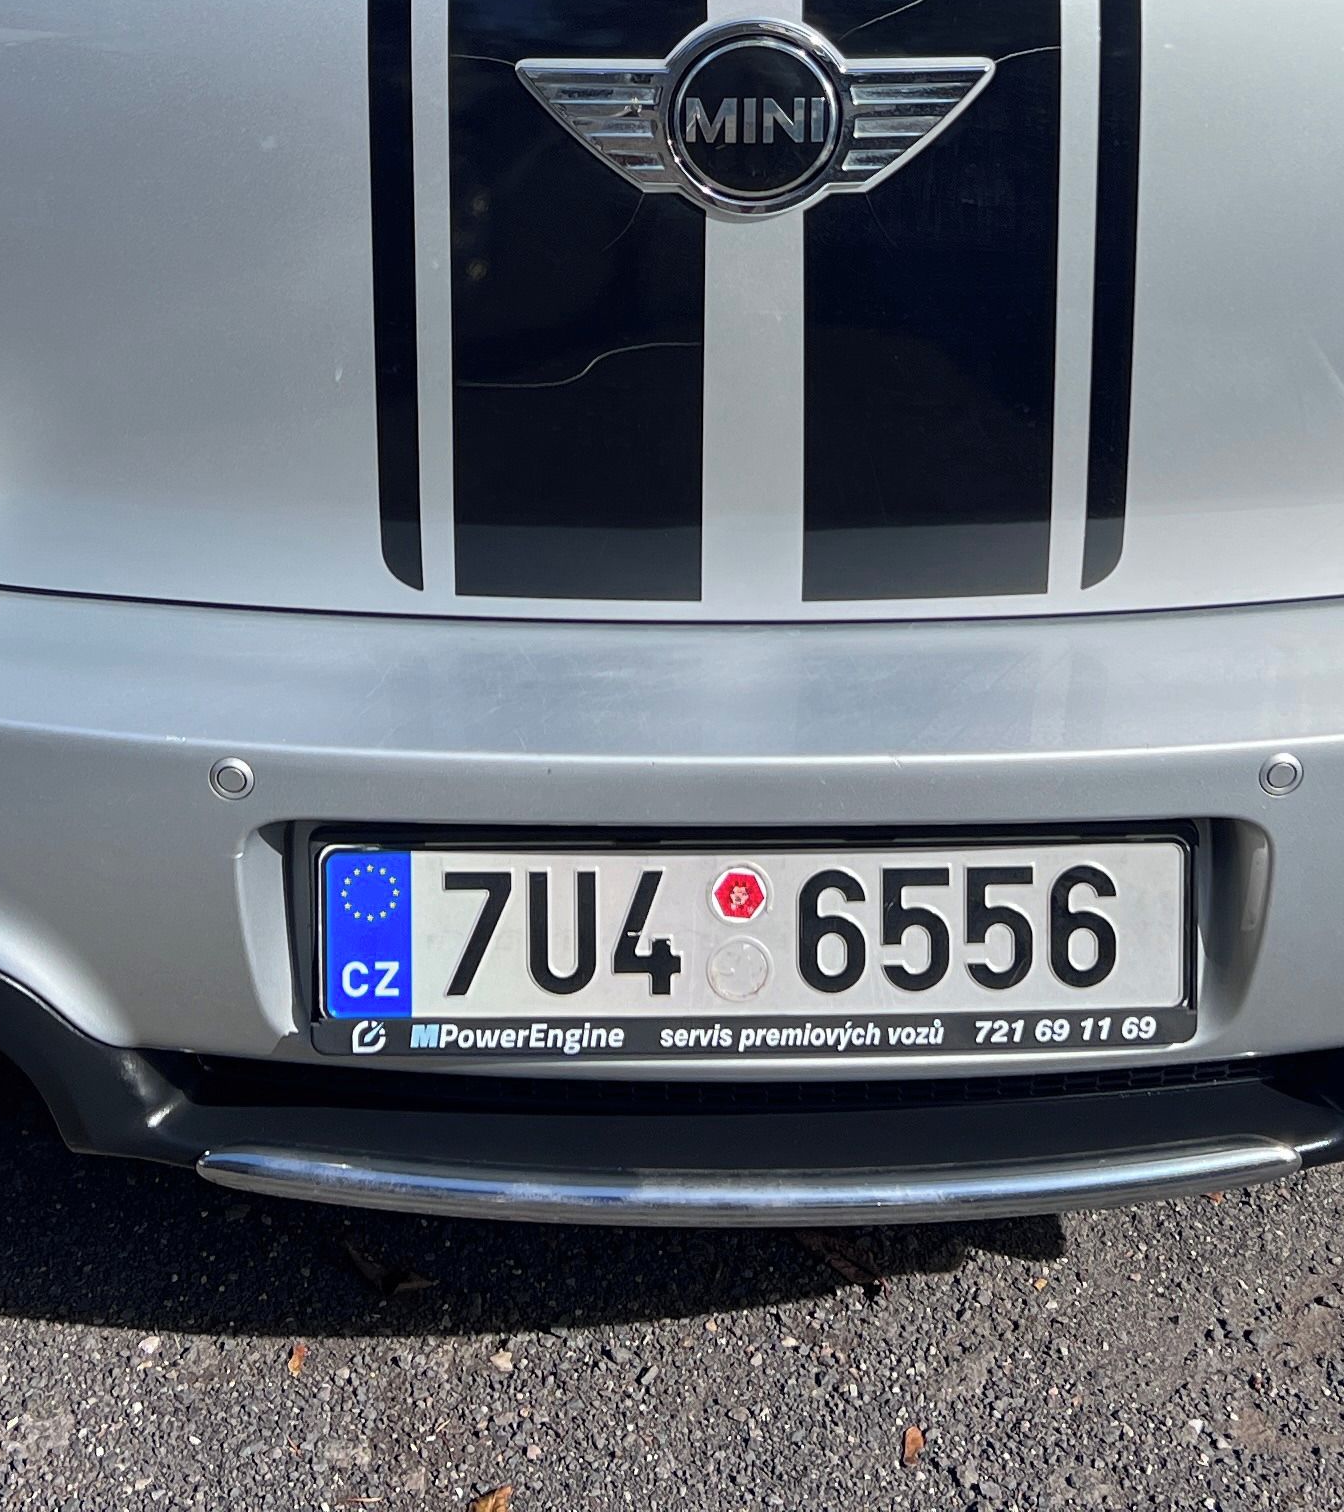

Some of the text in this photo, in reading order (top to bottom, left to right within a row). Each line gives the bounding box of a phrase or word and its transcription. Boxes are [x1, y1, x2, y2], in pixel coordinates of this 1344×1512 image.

[685, 96, 825, 144] MINI
[442, 864, 1120, 998] 7U4 6556
[342, 960, 400, 997] CZ
[410, 1016, 1157, 1055] MPowerEngine servis premiových vozů 721 69 11 69
